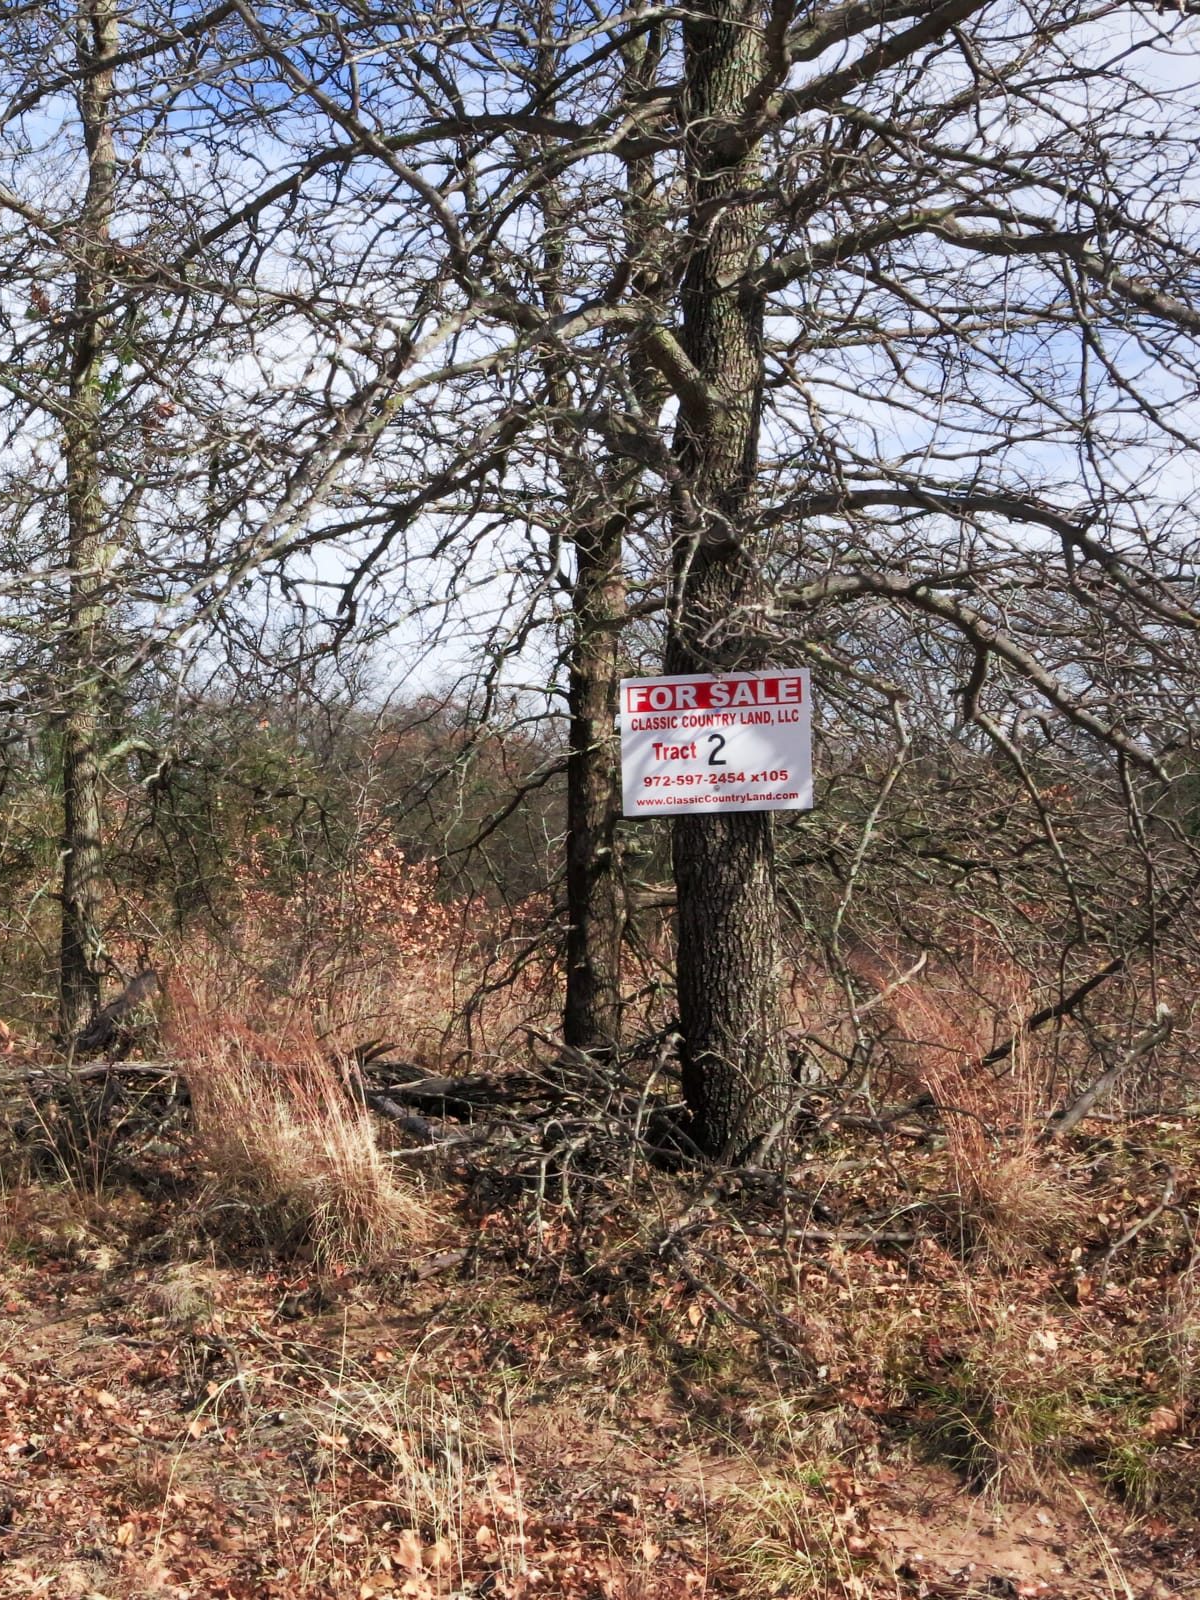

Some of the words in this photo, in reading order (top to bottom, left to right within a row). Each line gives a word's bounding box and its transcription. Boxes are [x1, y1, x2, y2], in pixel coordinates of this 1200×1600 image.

[629, 685, 696, 711] FOR
[709, 679, 799, 707] SALE
[631, 715, 678, 731] CLASSIC
[682, 712, 736, 729] COUNTRY
[740, 710, 775, 726] LAND,
[778, 709, 799, 723] LLC
[652, 742, 697, 760] Tract
[707, 733, 727, 766] 2
[643, 772, 745, 787] 972-597-2454
[751, 770, 788, 783] x105
[636, 791, 799, 806] www.ClassicCountryLand.com
